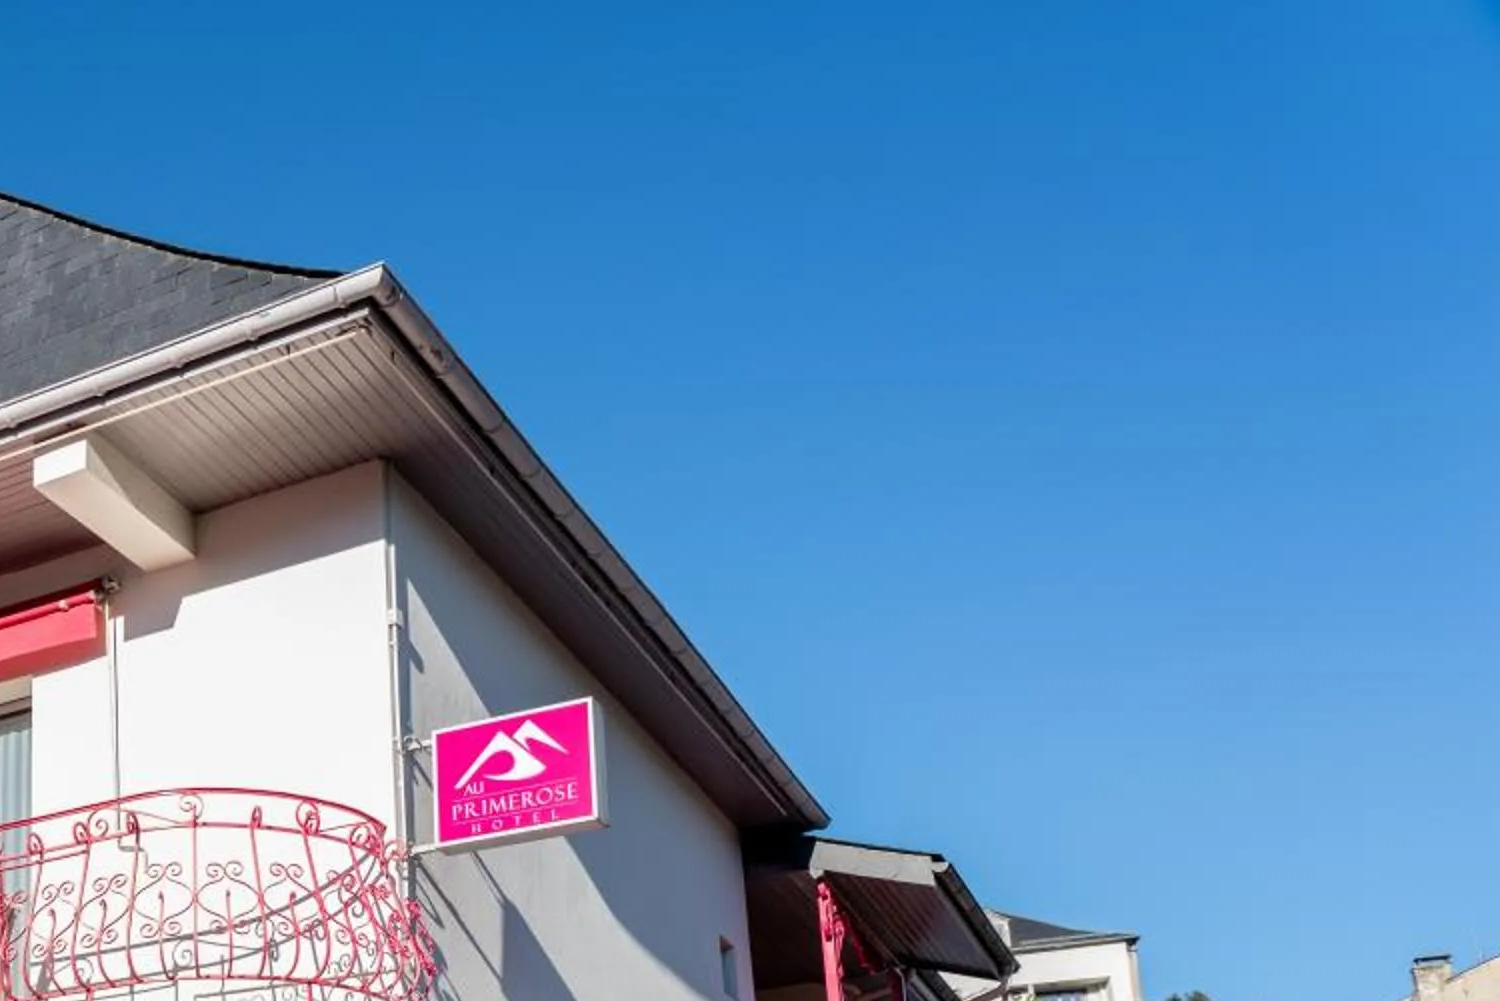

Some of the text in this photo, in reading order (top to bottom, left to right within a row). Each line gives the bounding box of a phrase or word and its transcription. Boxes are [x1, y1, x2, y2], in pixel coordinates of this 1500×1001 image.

[452, 782, 579, 821] PRIMEROSE
[464, 781, 485, 797] AU
[471, 809, 560, 834] HOTEL
